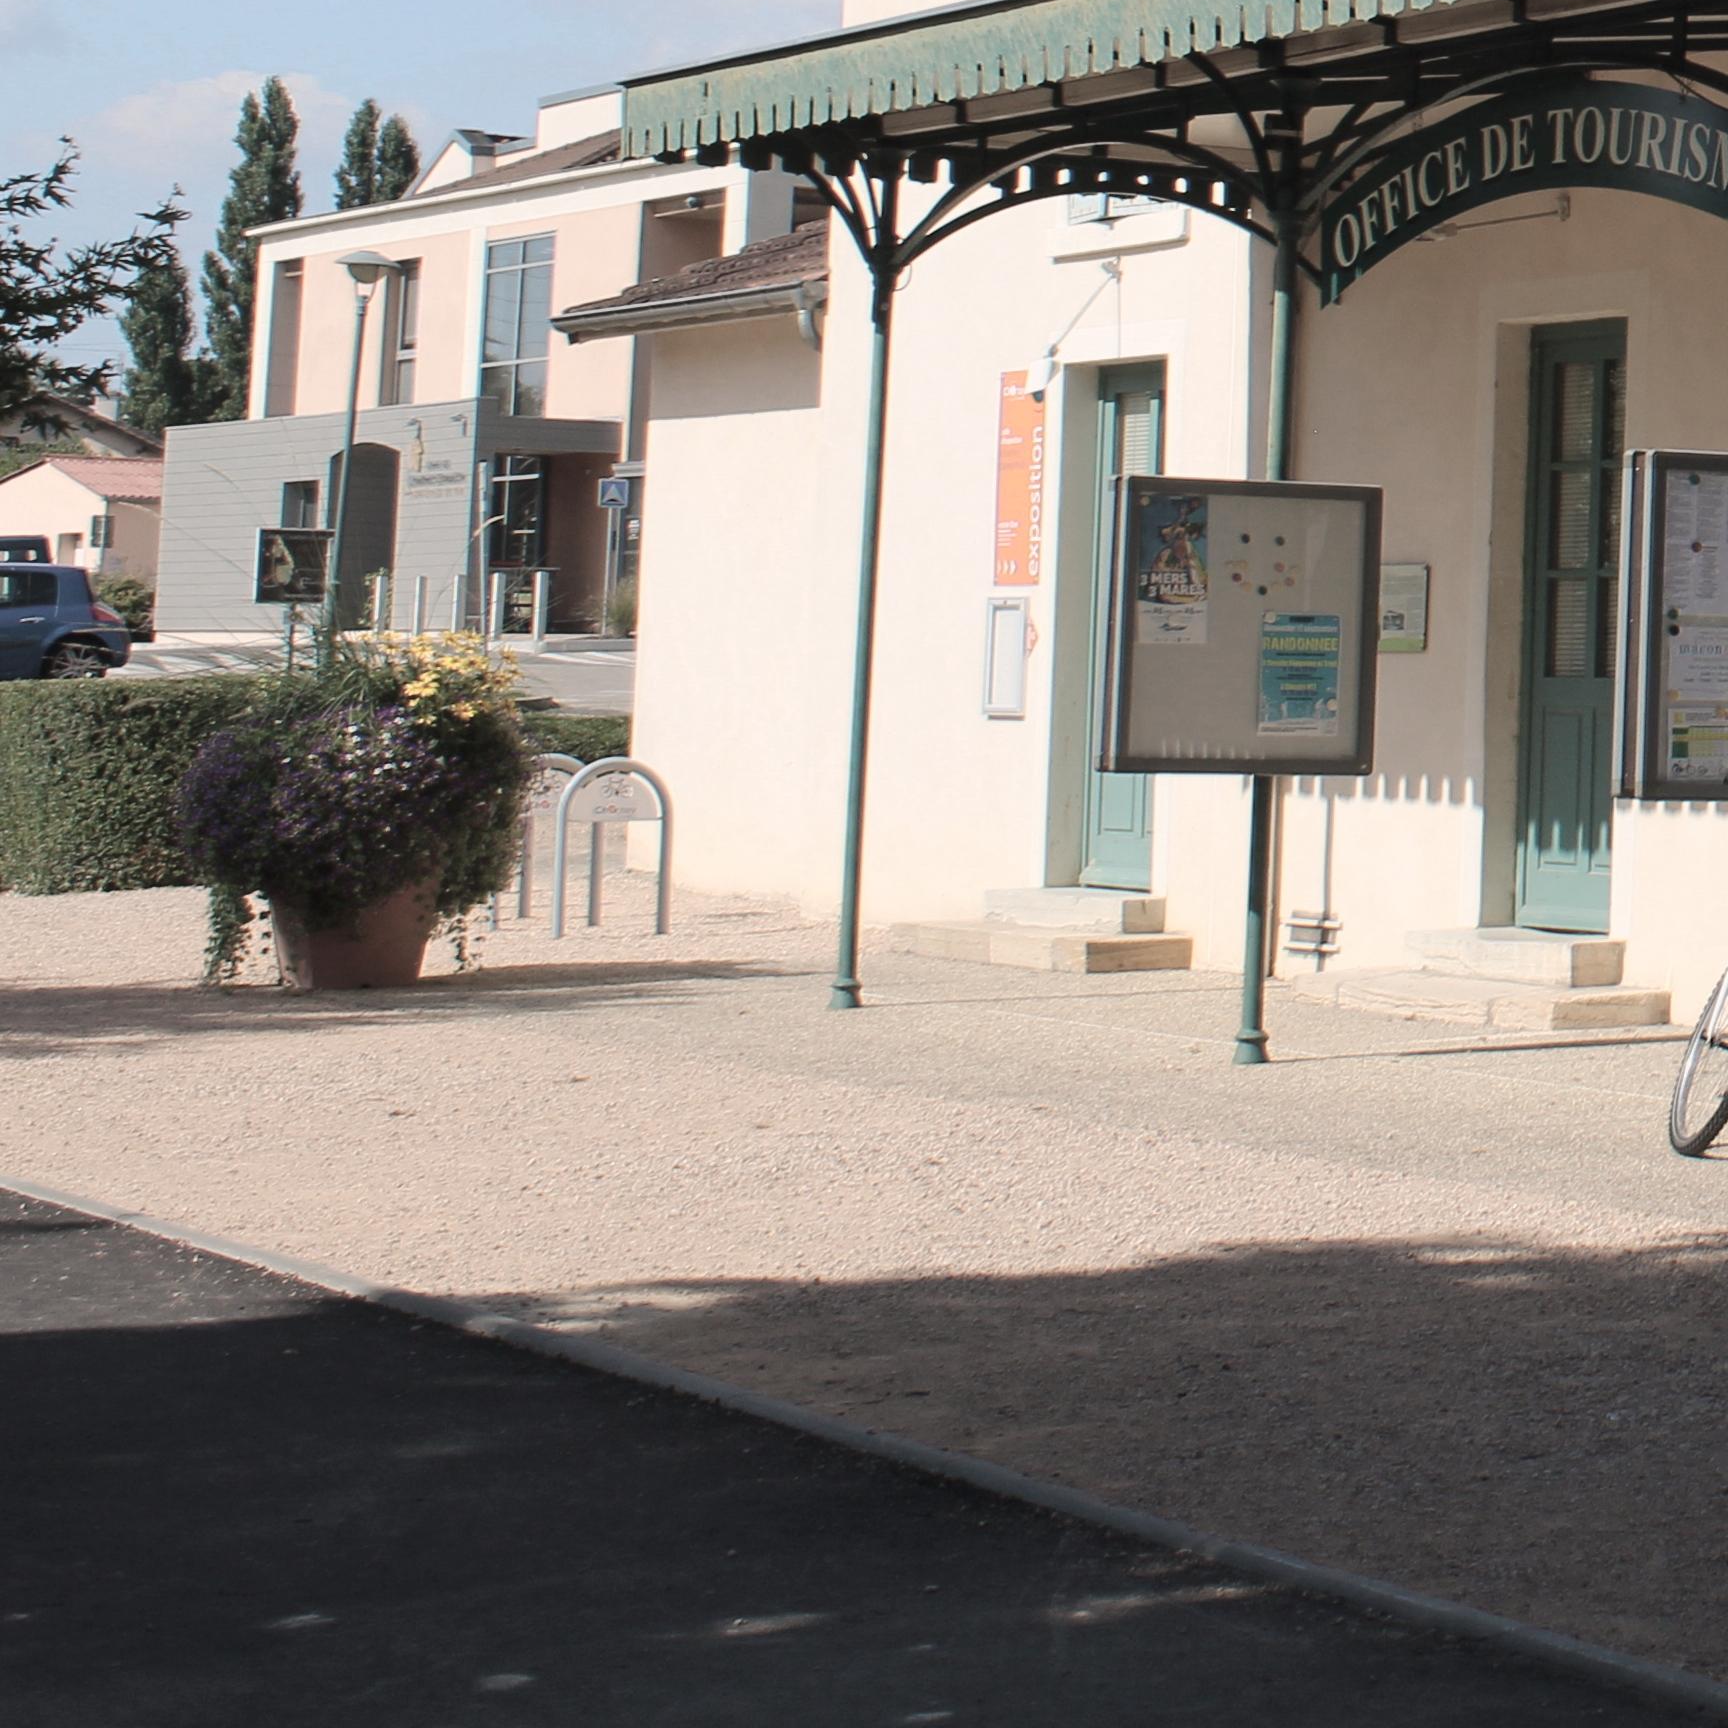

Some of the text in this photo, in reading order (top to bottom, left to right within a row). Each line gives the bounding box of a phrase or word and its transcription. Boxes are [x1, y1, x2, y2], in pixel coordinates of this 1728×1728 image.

[1332, 135, 1472, 269] OFFICE
[1479, 113, 1536, 182] DE
[1028, 425, 1044, 577] exposition
[1139, 572, 1189, 586] 3 MERS
[1148, 585, 1157, 597] 3
